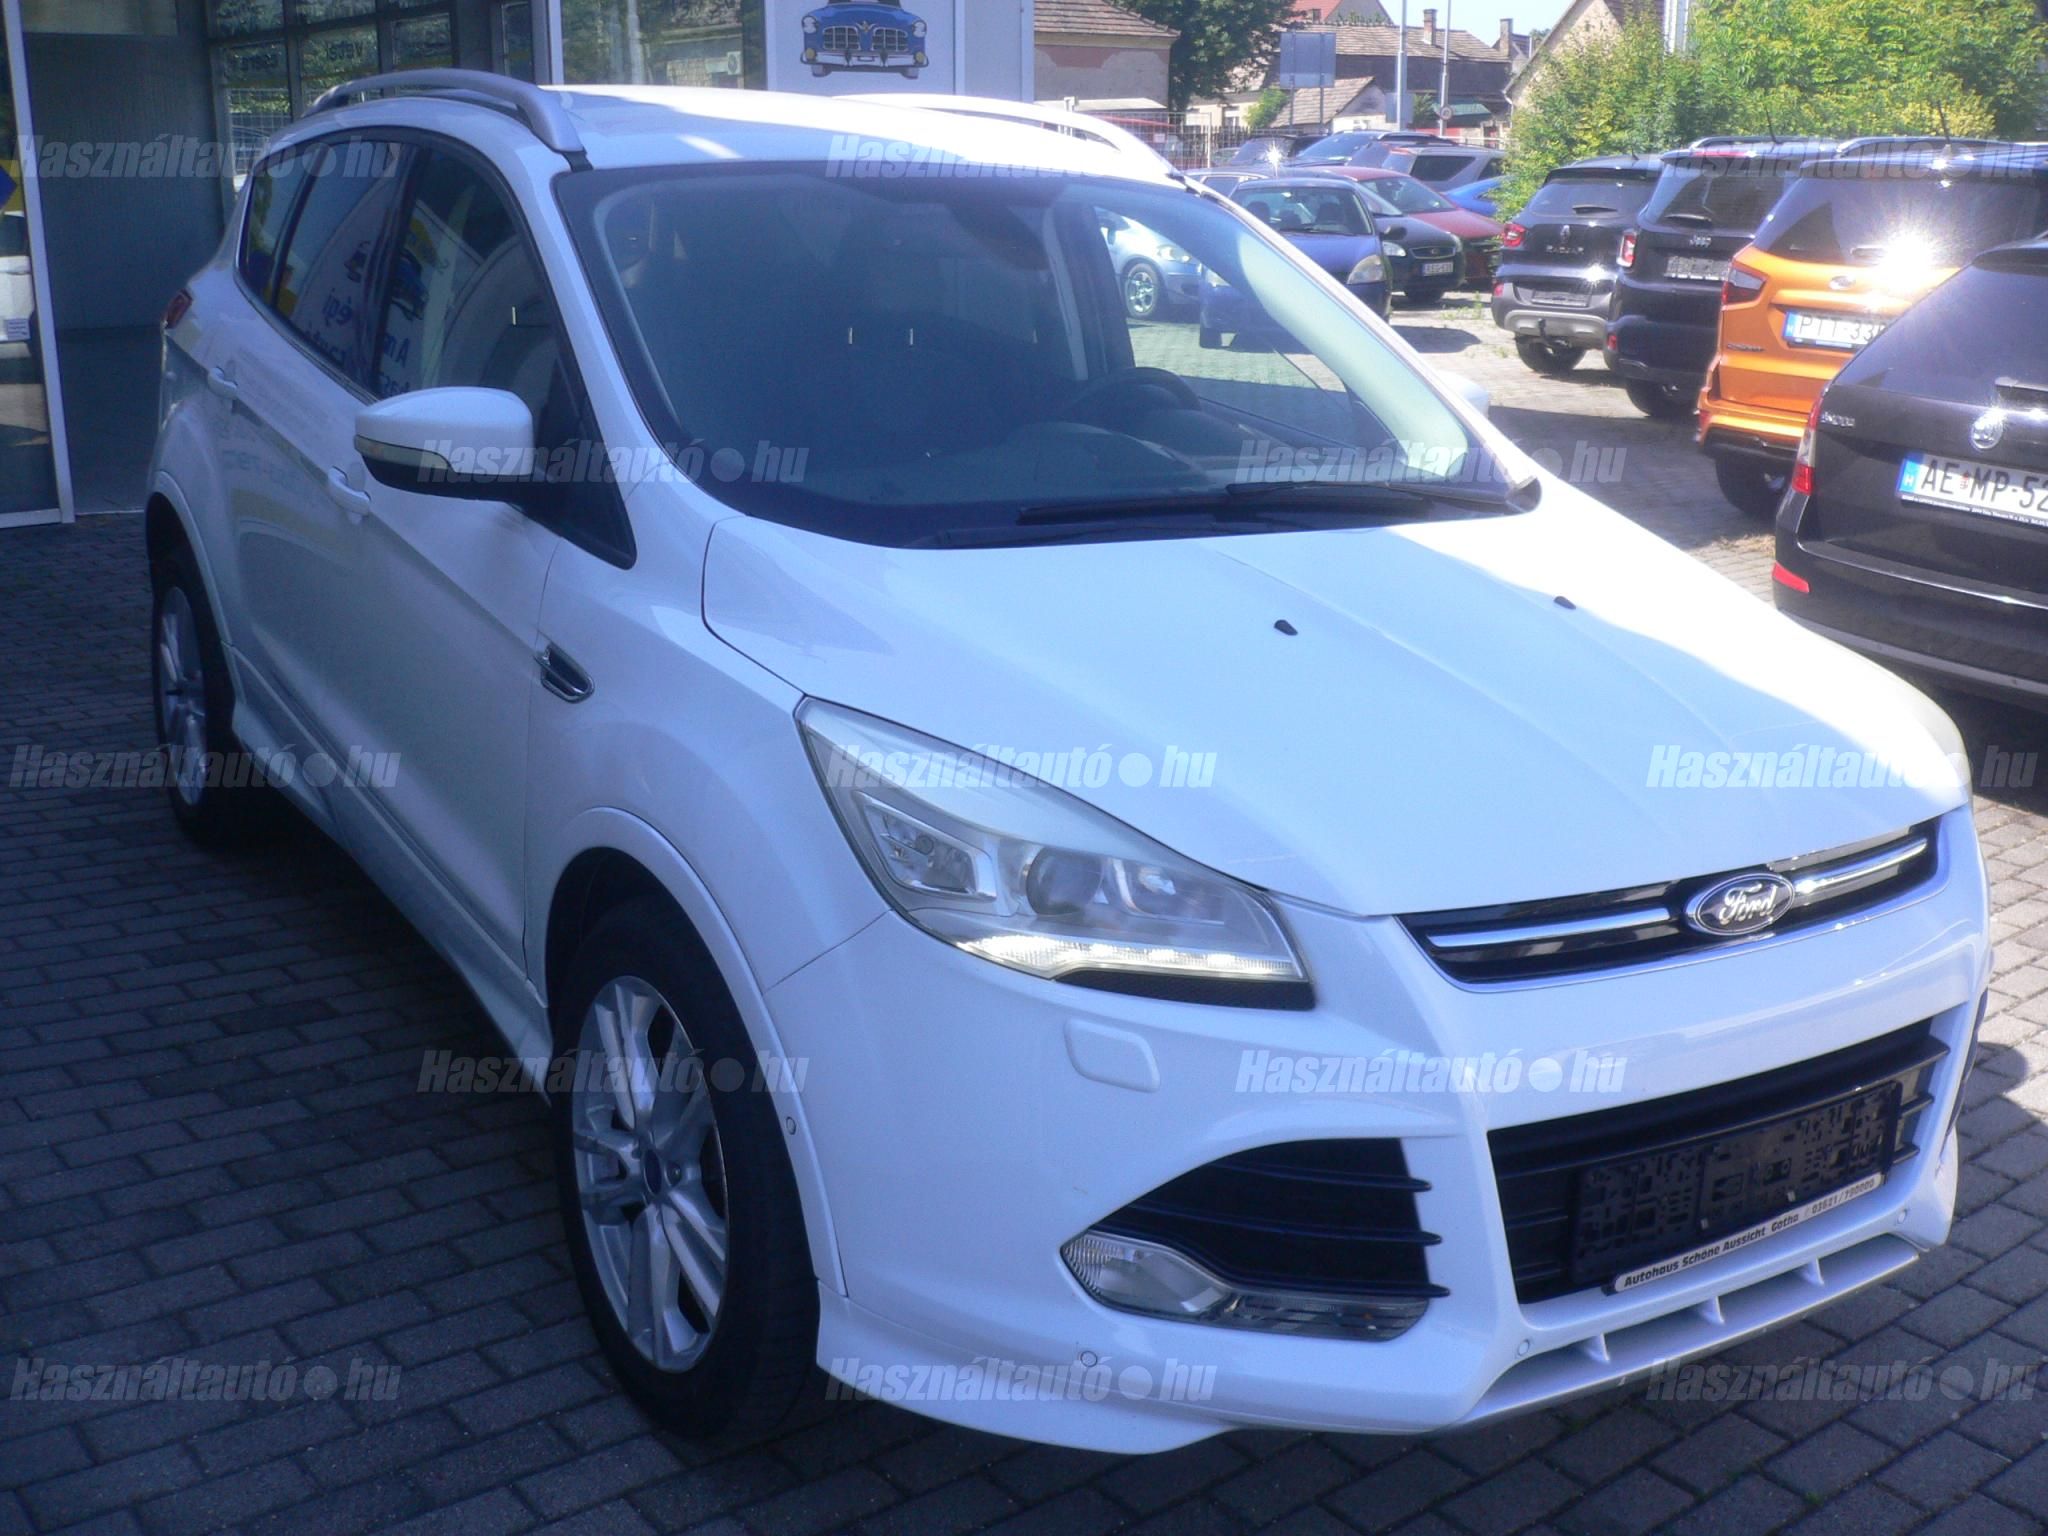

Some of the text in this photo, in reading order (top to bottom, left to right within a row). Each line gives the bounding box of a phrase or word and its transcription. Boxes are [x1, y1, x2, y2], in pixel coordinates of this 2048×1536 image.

[1719, 883, 1778, 925] Ford
[1624, 1260, 1679, 1287] Autohaus
[1723, 1227, 1766, 1251] Aussicht
[1771, 1212, 1799, 1233] Gotha
